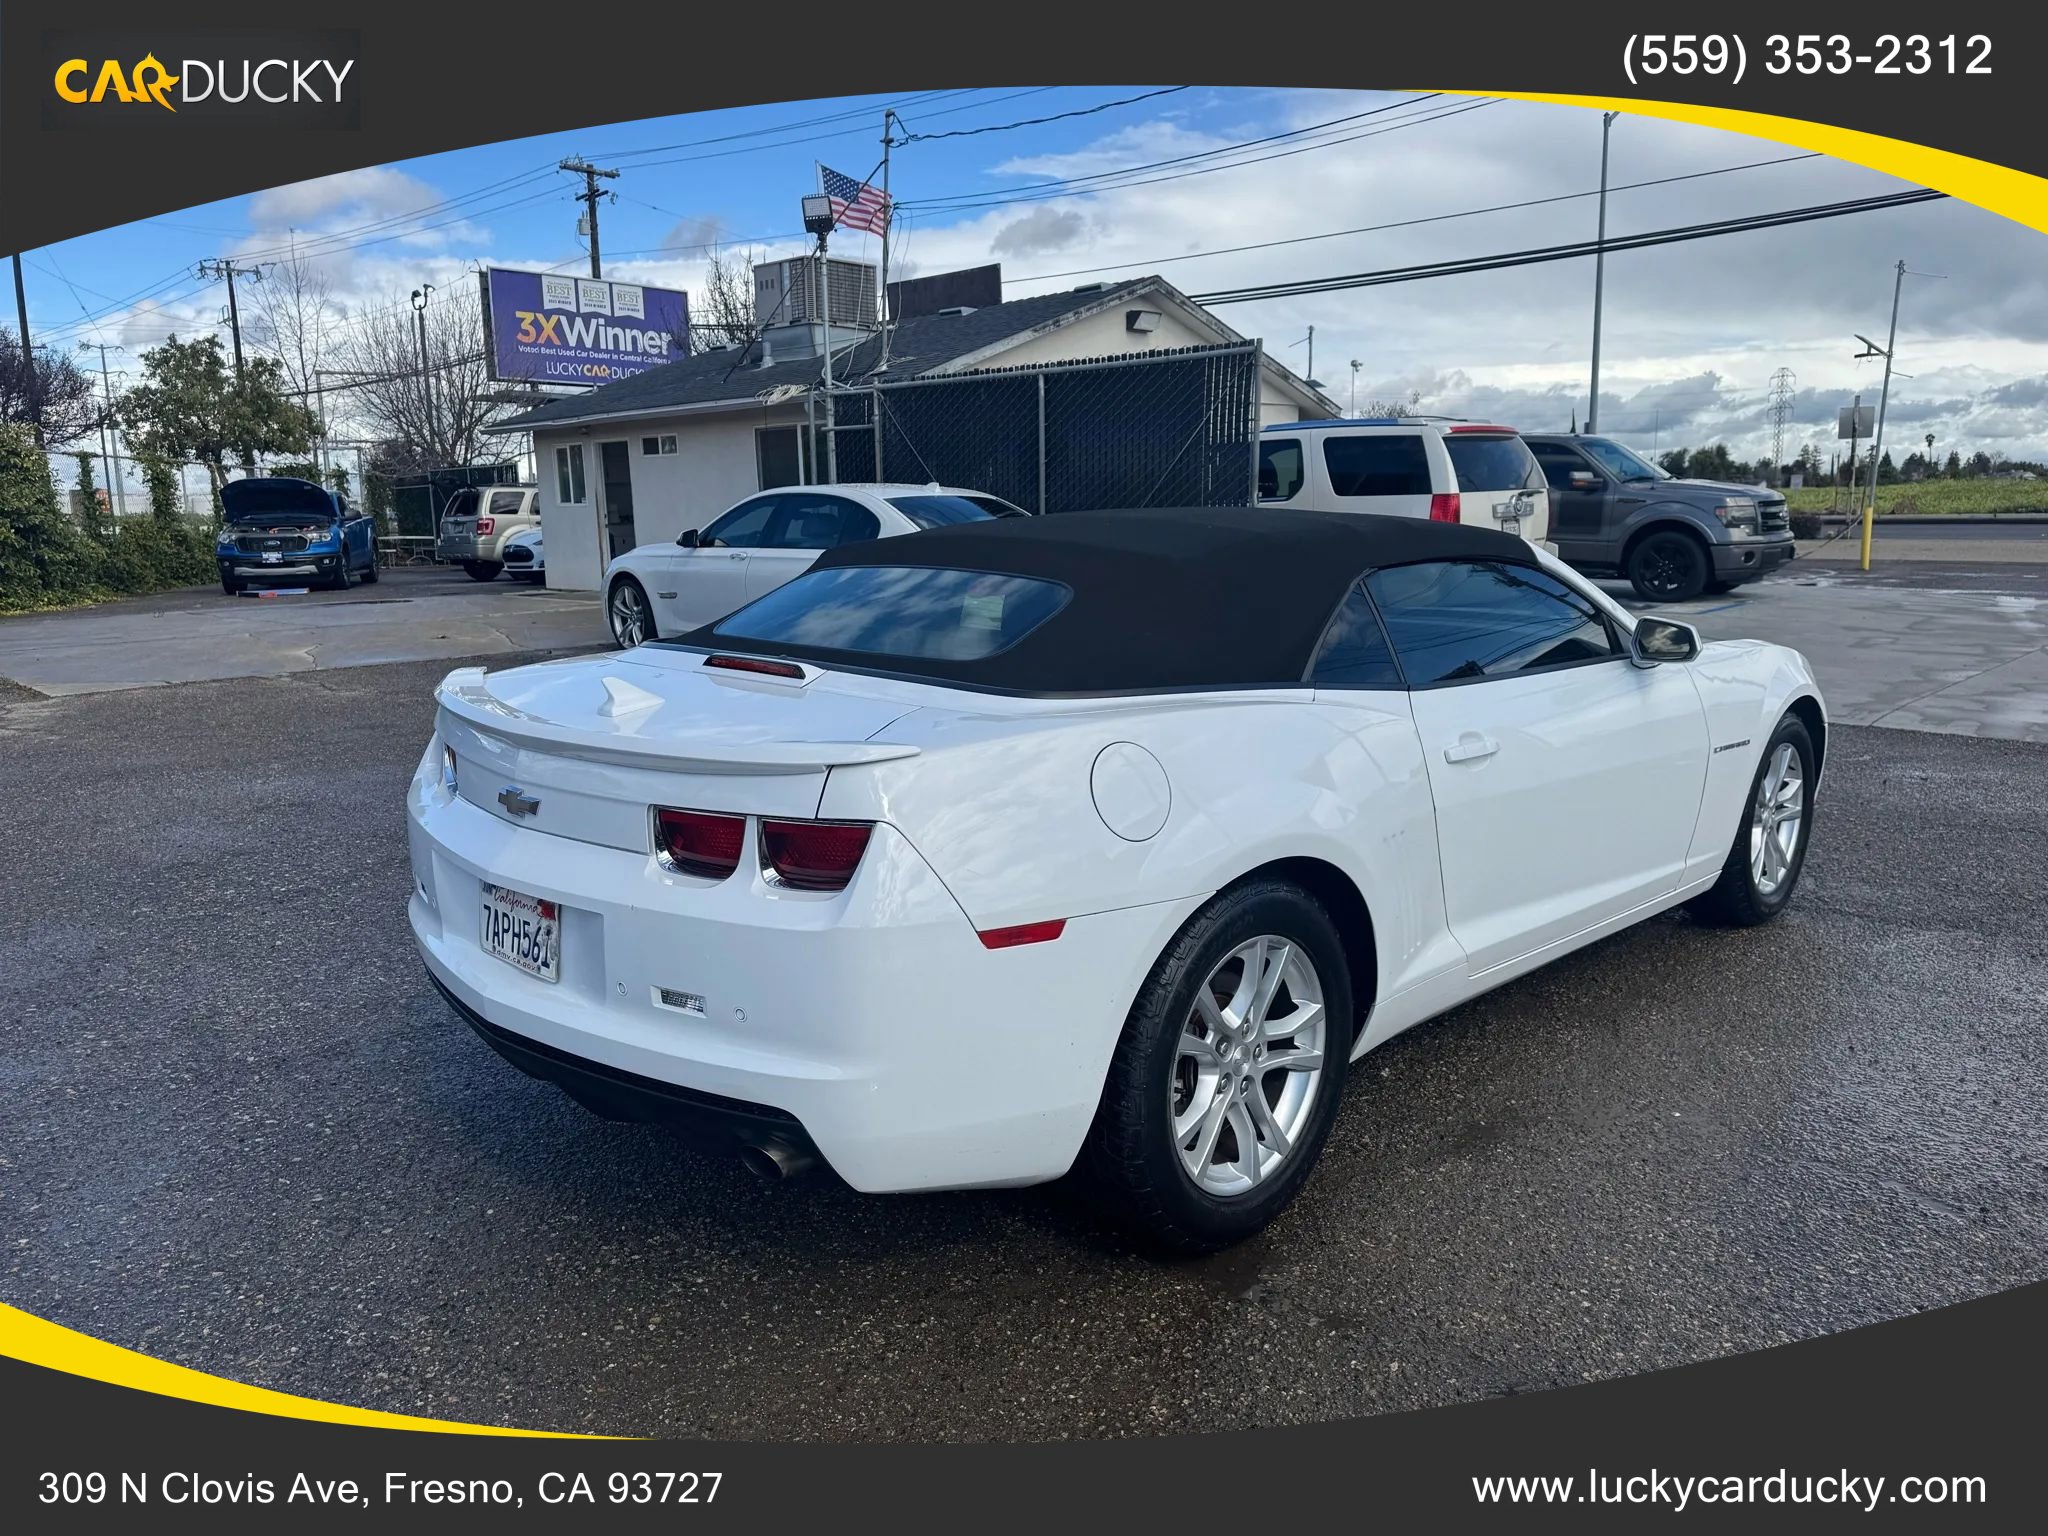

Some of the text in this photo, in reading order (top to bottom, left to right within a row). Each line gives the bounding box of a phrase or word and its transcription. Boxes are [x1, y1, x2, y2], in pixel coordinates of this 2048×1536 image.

[546, 284, 572, 296] BEST
[582, 288, 607, 300] BEST
[616, 292, 640, 304] BEST
[518, 345, 539, 353] Voted
[541, 347, 557, 355] Best
[558, 348, 575, 357] Used
[589, 351, 611, 359] Dealer
[620, 354, 642, 362] Central
[493, 885, 545, 918] California
[483, 904, 551, 970] 7APH561
